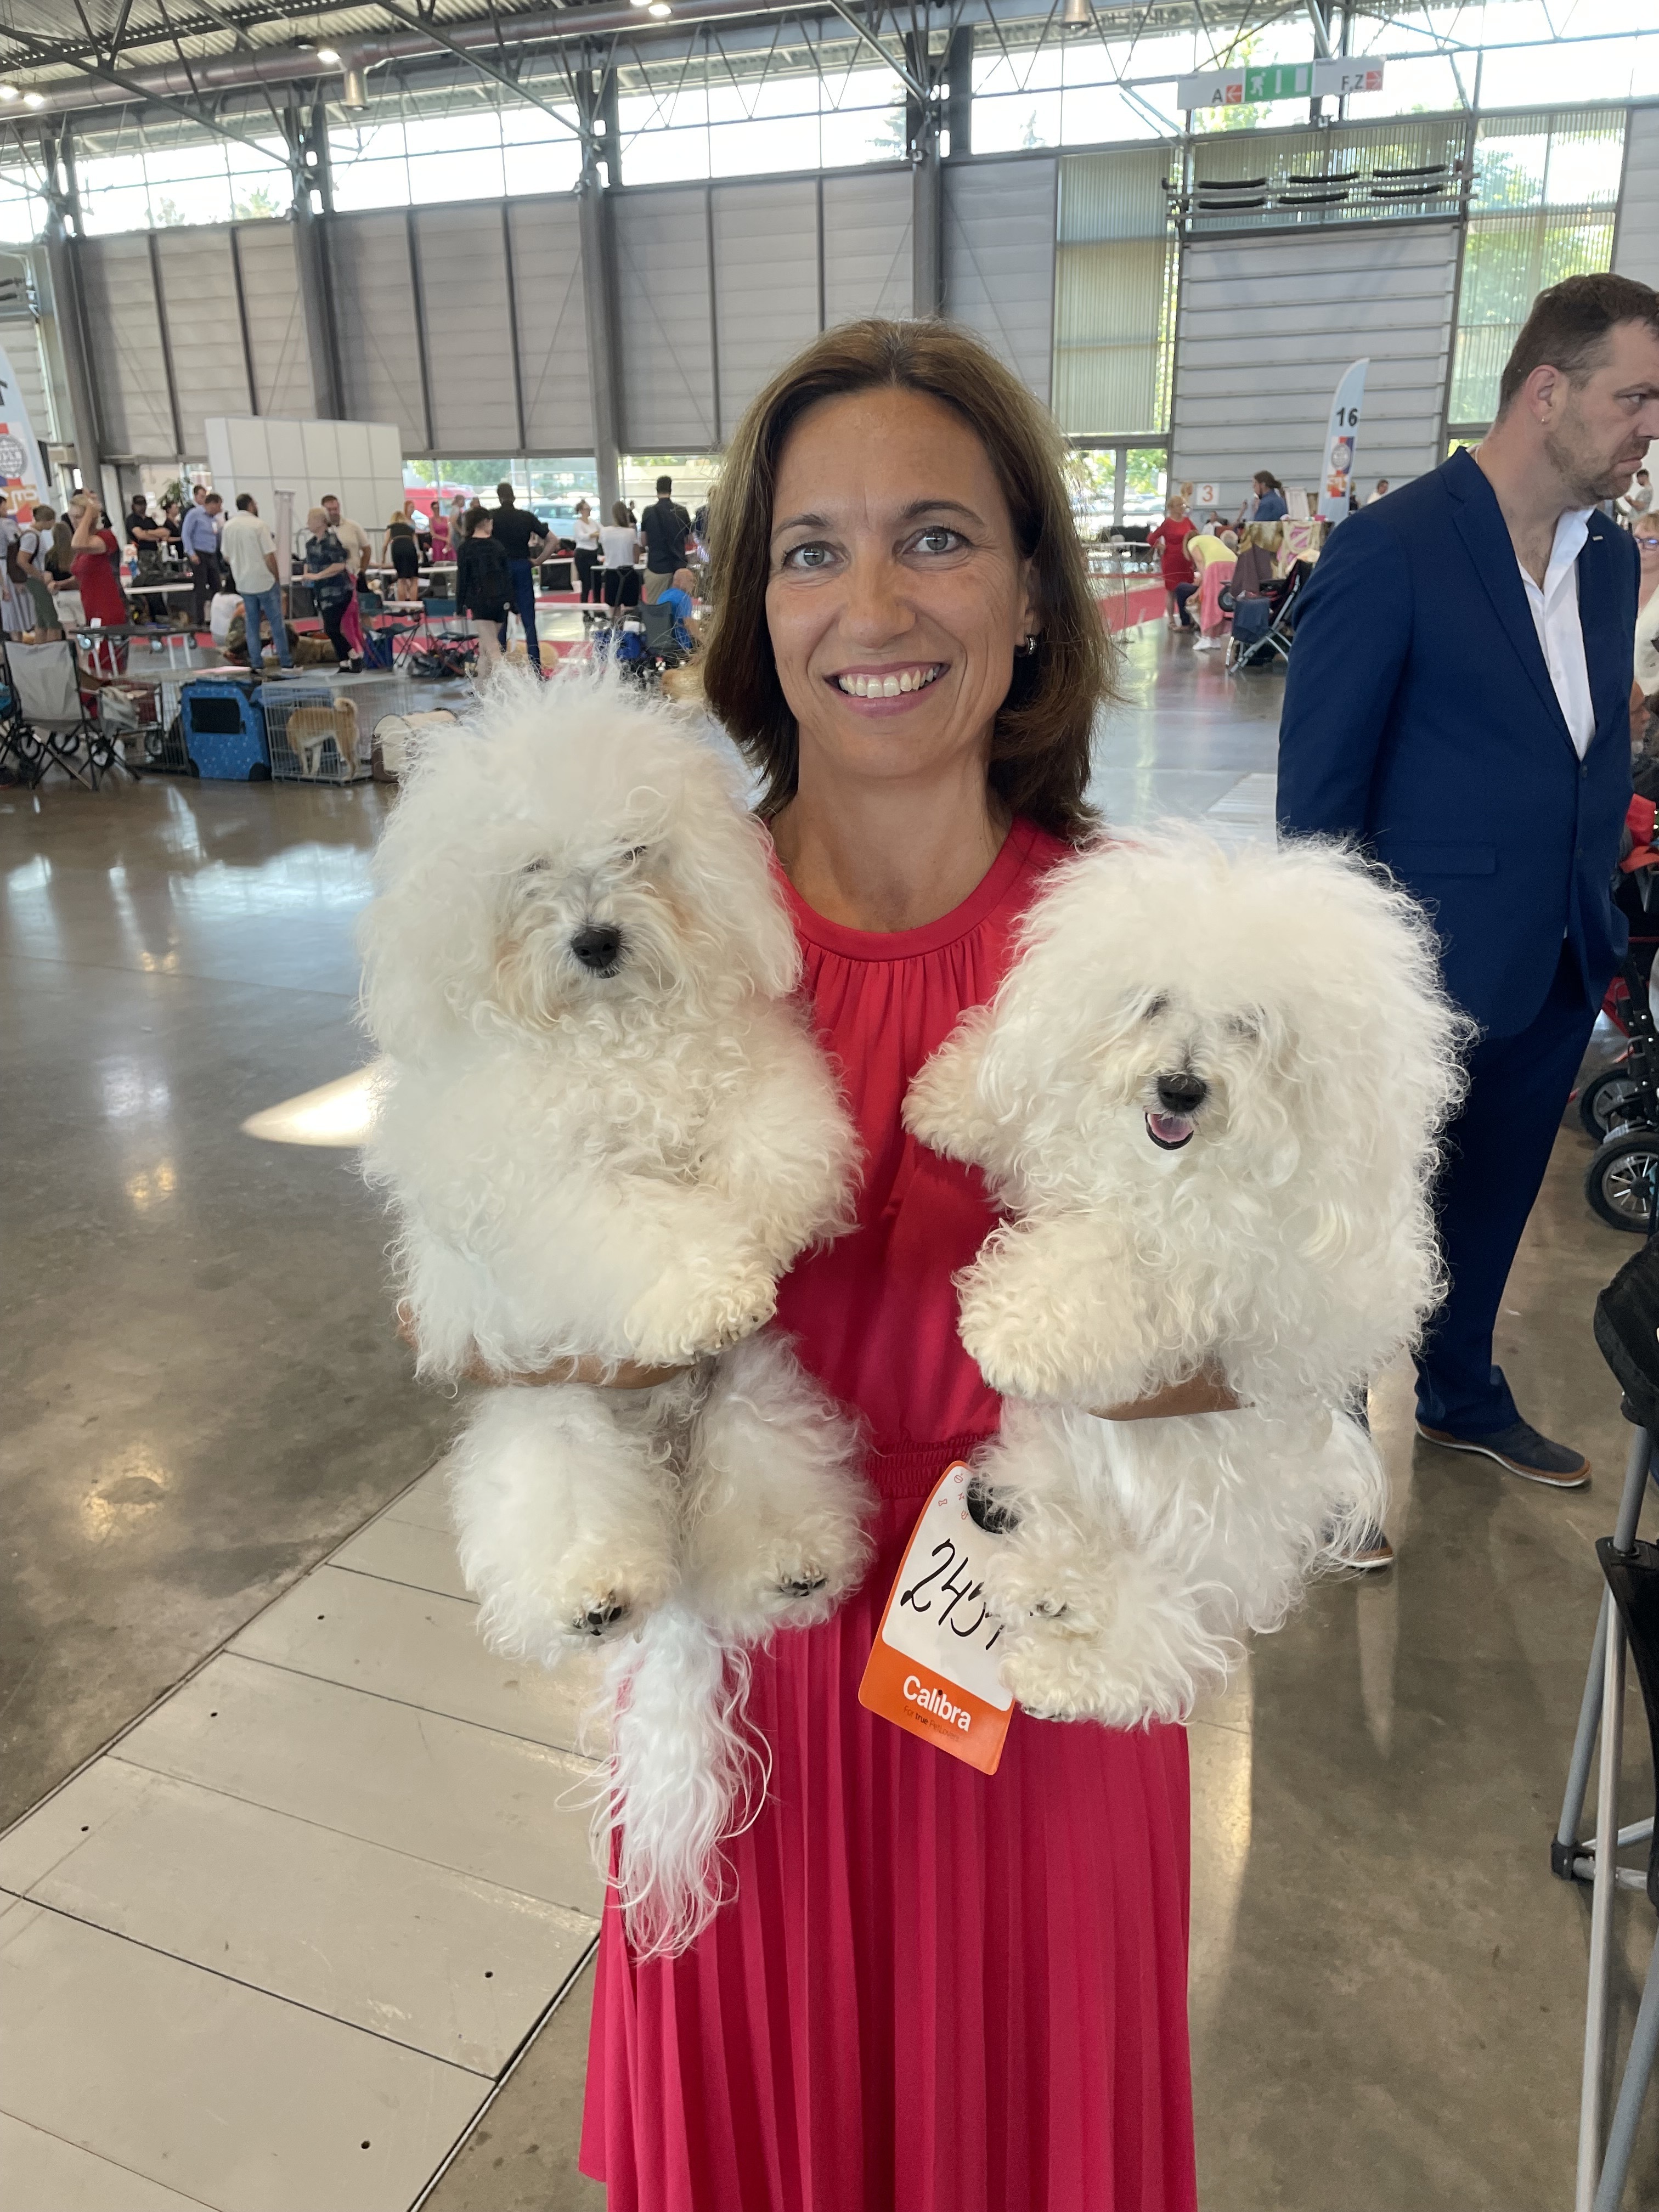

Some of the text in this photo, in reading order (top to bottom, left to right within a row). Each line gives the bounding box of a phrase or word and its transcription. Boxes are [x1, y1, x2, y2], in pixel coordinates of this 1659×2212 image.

[1211, 88, 1223, 103] A
[1336, 408, 1358, 426] 16
[1203, 484, 1214, 503] 3
[903, 1675, 971, 1732] Calibra
[915, 1712, 929, 1725] true
